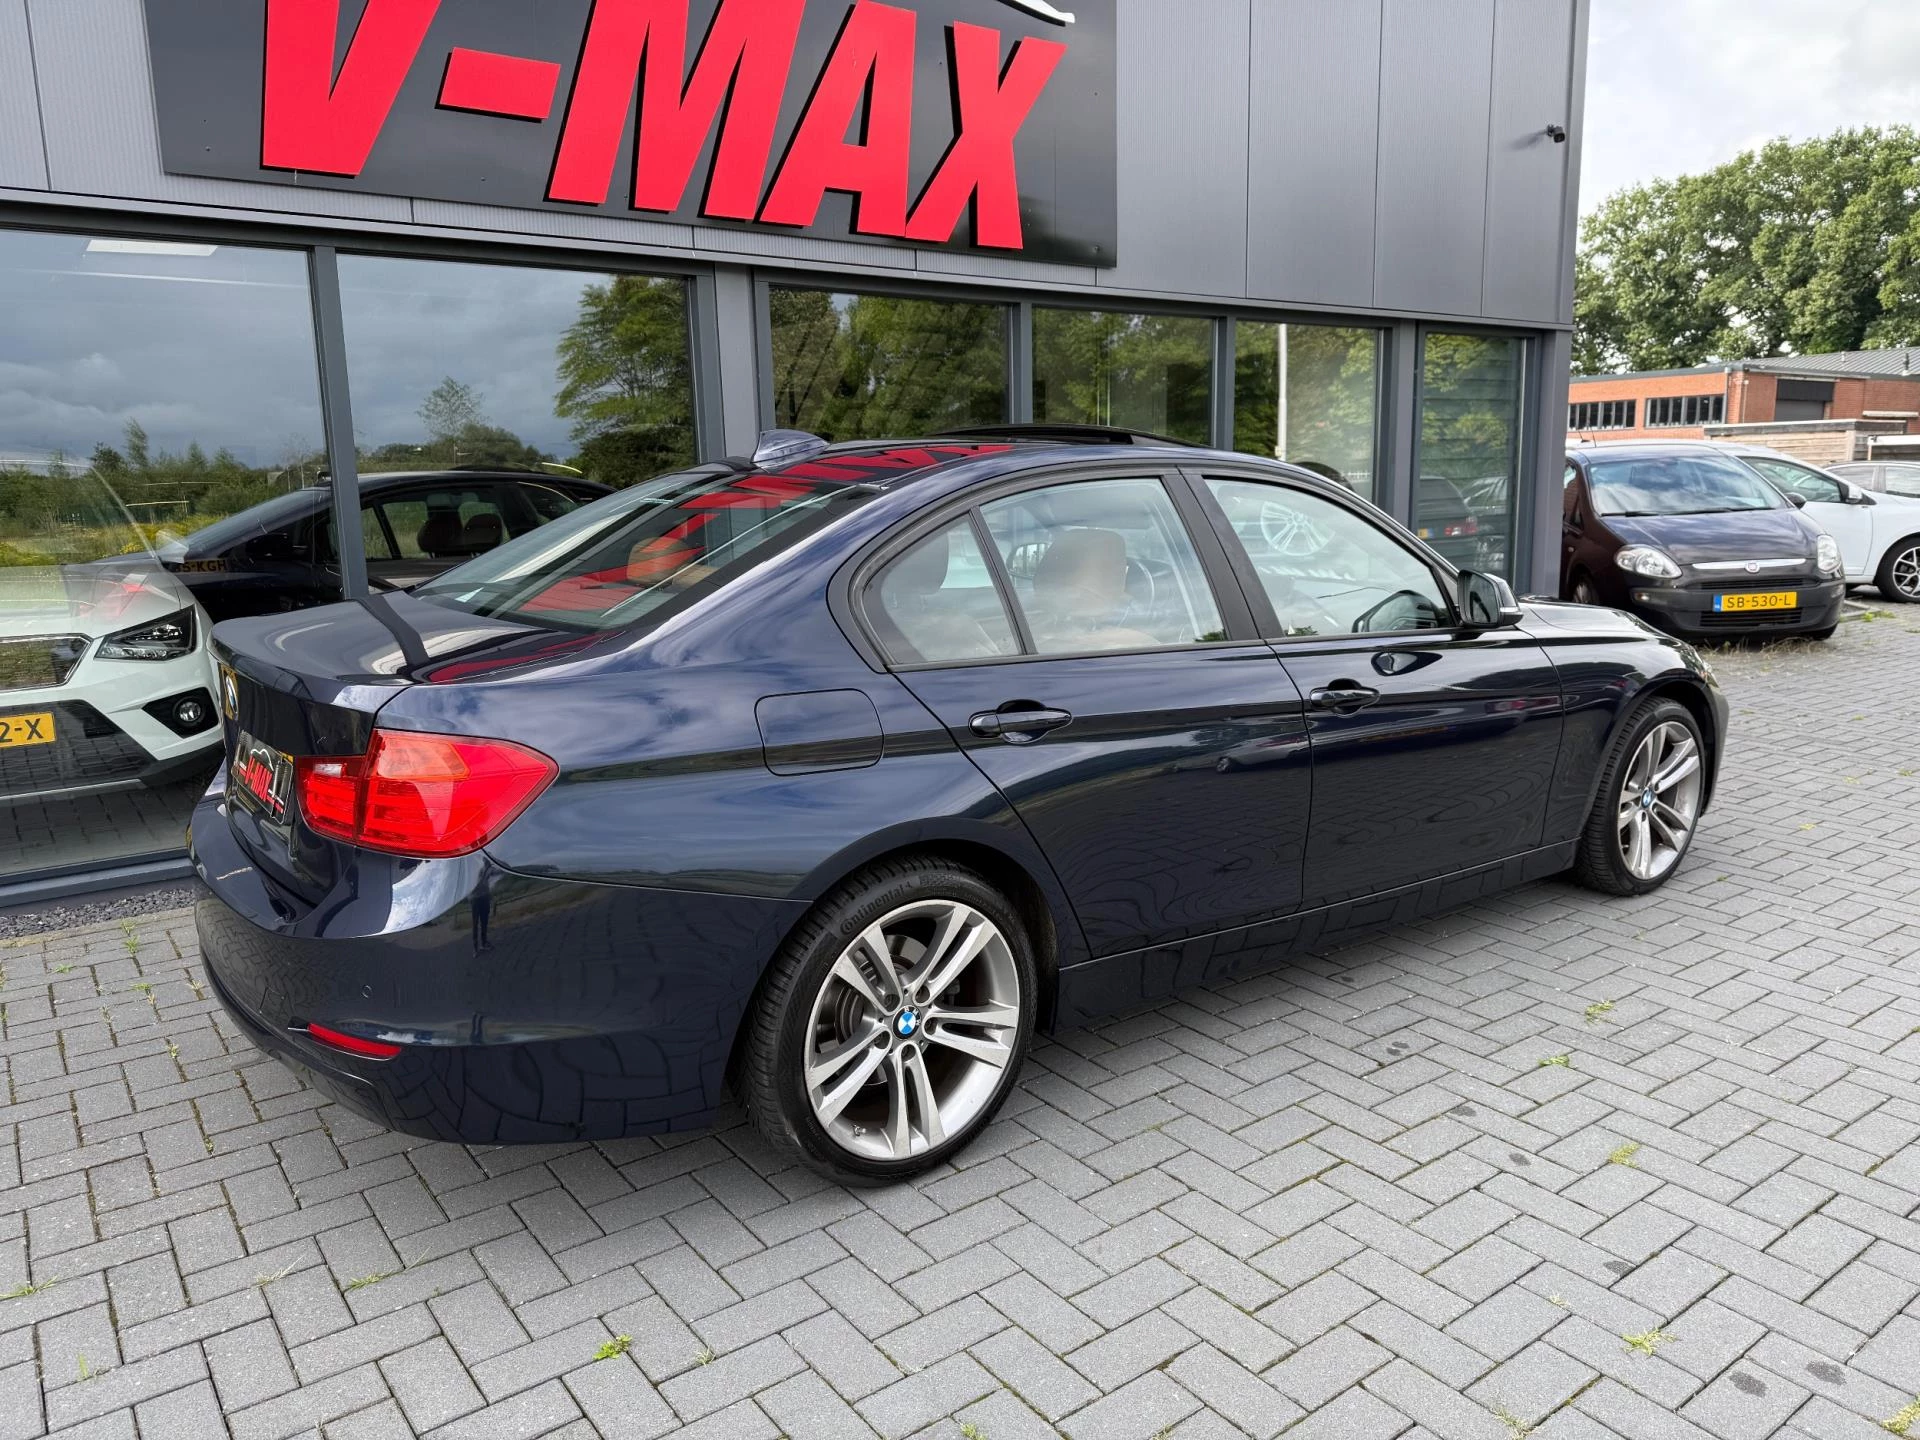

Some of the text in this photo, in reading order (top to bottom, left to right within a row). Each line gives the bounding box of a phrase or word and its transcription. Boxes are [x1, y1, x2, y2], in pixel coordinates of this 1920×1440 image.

[261, 0, 1067, 249] V-MAX
[1727, 594, 1791, 608] SB-530-L
[840, 884, 905, 935] Continental
